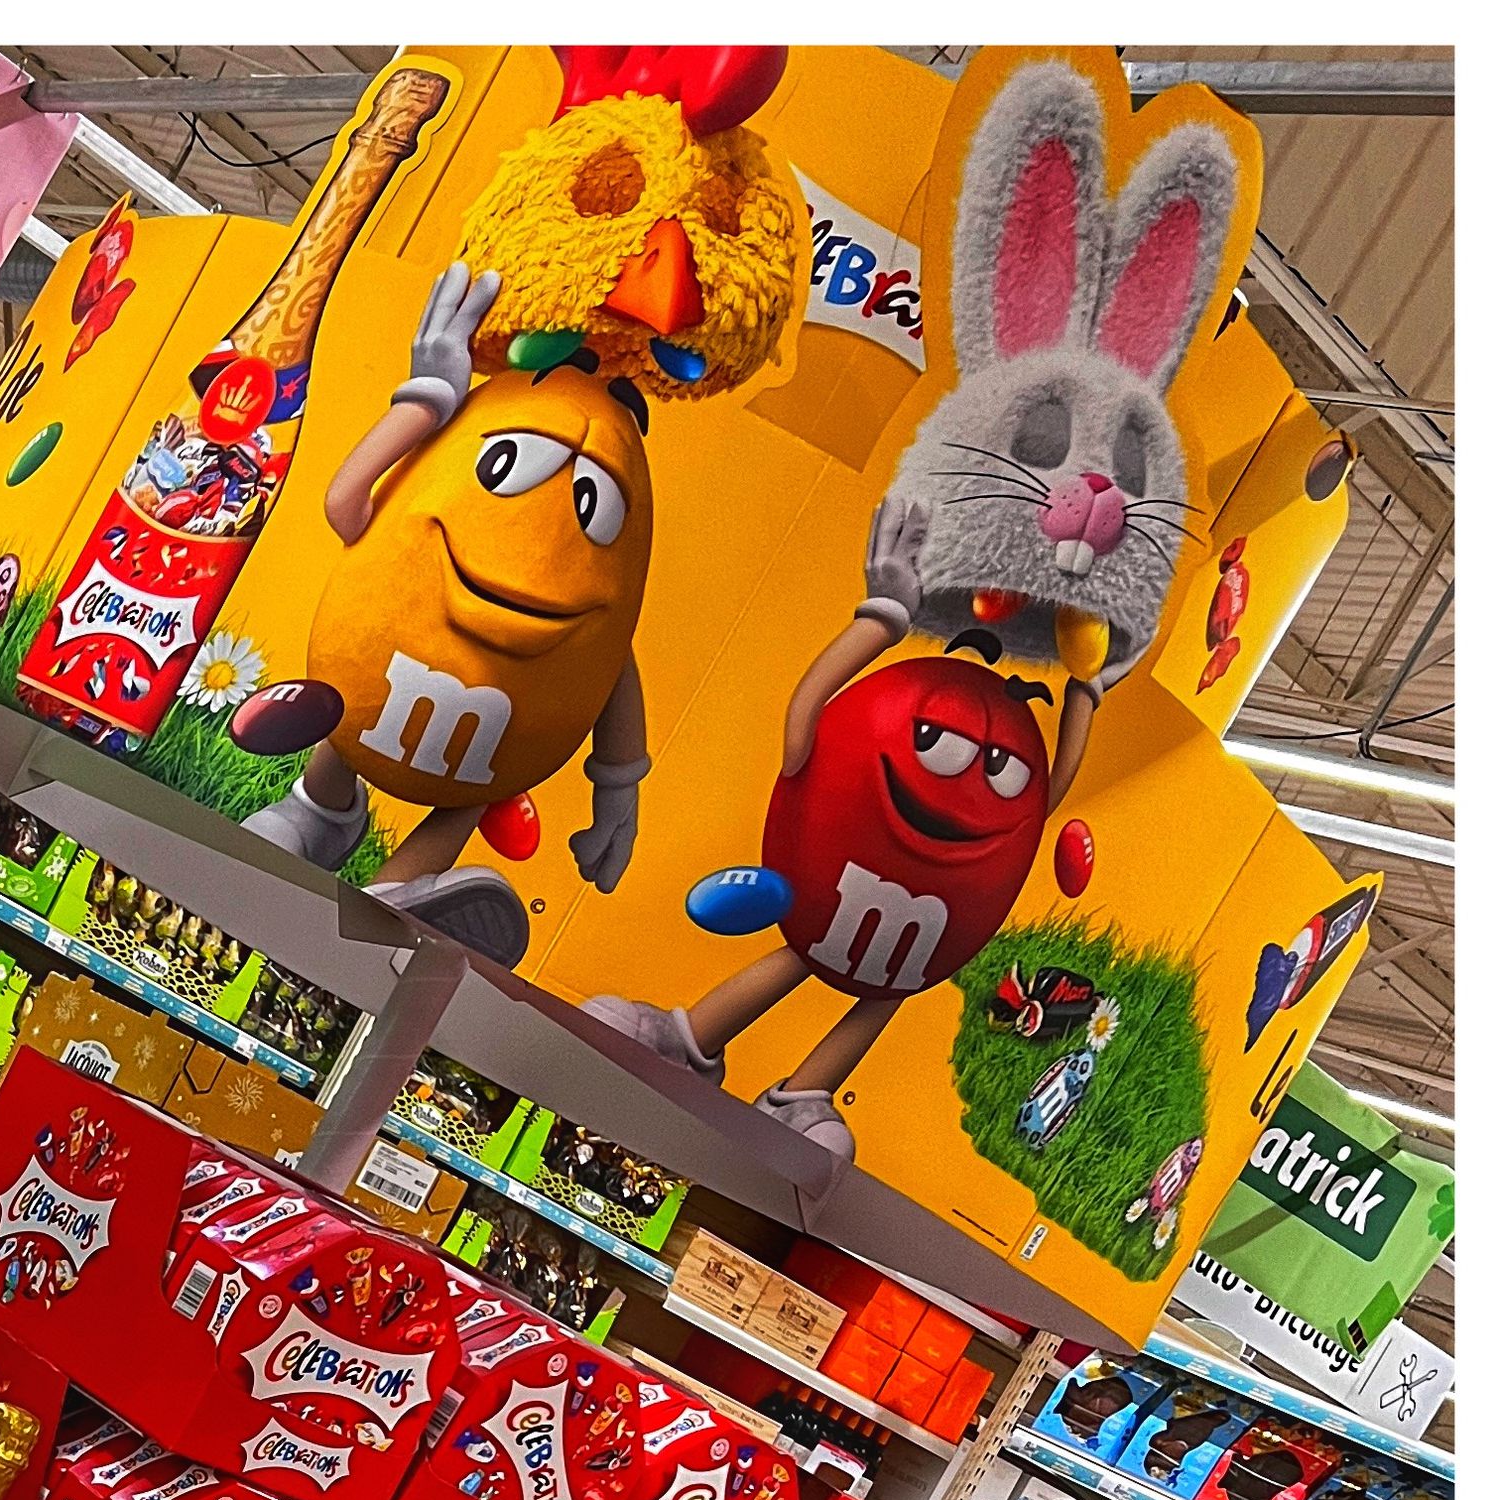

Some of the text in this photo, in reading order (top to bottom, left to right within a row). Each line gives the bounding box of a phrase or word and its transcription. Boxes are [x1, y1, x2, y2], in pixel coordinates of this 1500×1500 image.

[359, 650, 511, 785] m
[720, 869, 759, 885] m
[809, 862, 947, 990] m
[1250, 1124, 1385, 1234] atrick
